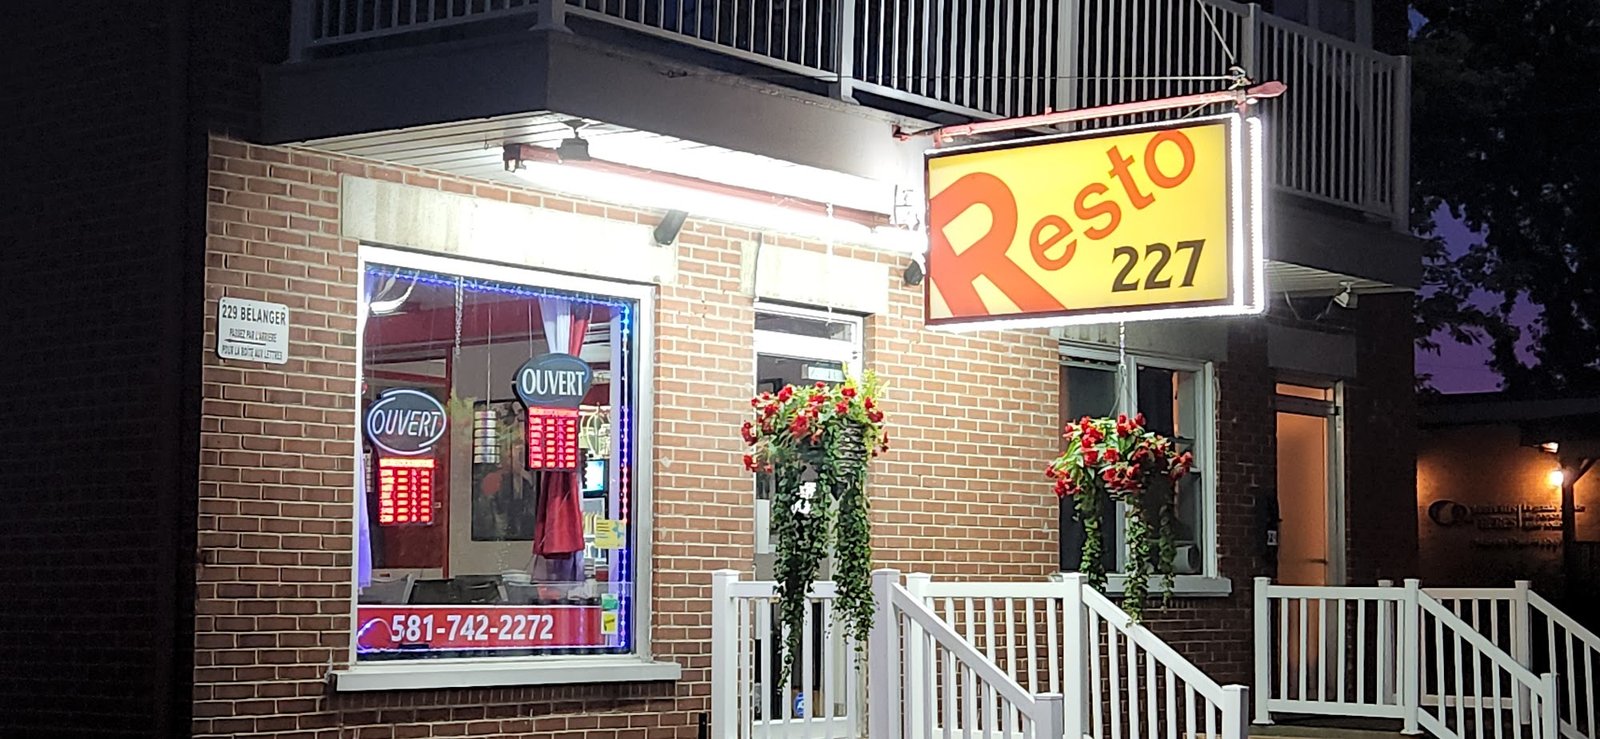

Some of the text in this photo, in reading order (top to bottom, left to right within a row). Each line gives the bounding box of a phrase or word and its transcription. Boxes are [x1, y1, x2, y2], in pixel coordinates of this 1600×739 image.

[929, 129, 1195, 316] Resto
[1111, 239, 1206, 292] 227
[222, 304, 238, 319] 229
[522, 368, 585, 396] OUVERT
[372, 409, 441, 437] OUVERT
[391, 614, 553, 641] 581-742-2272
